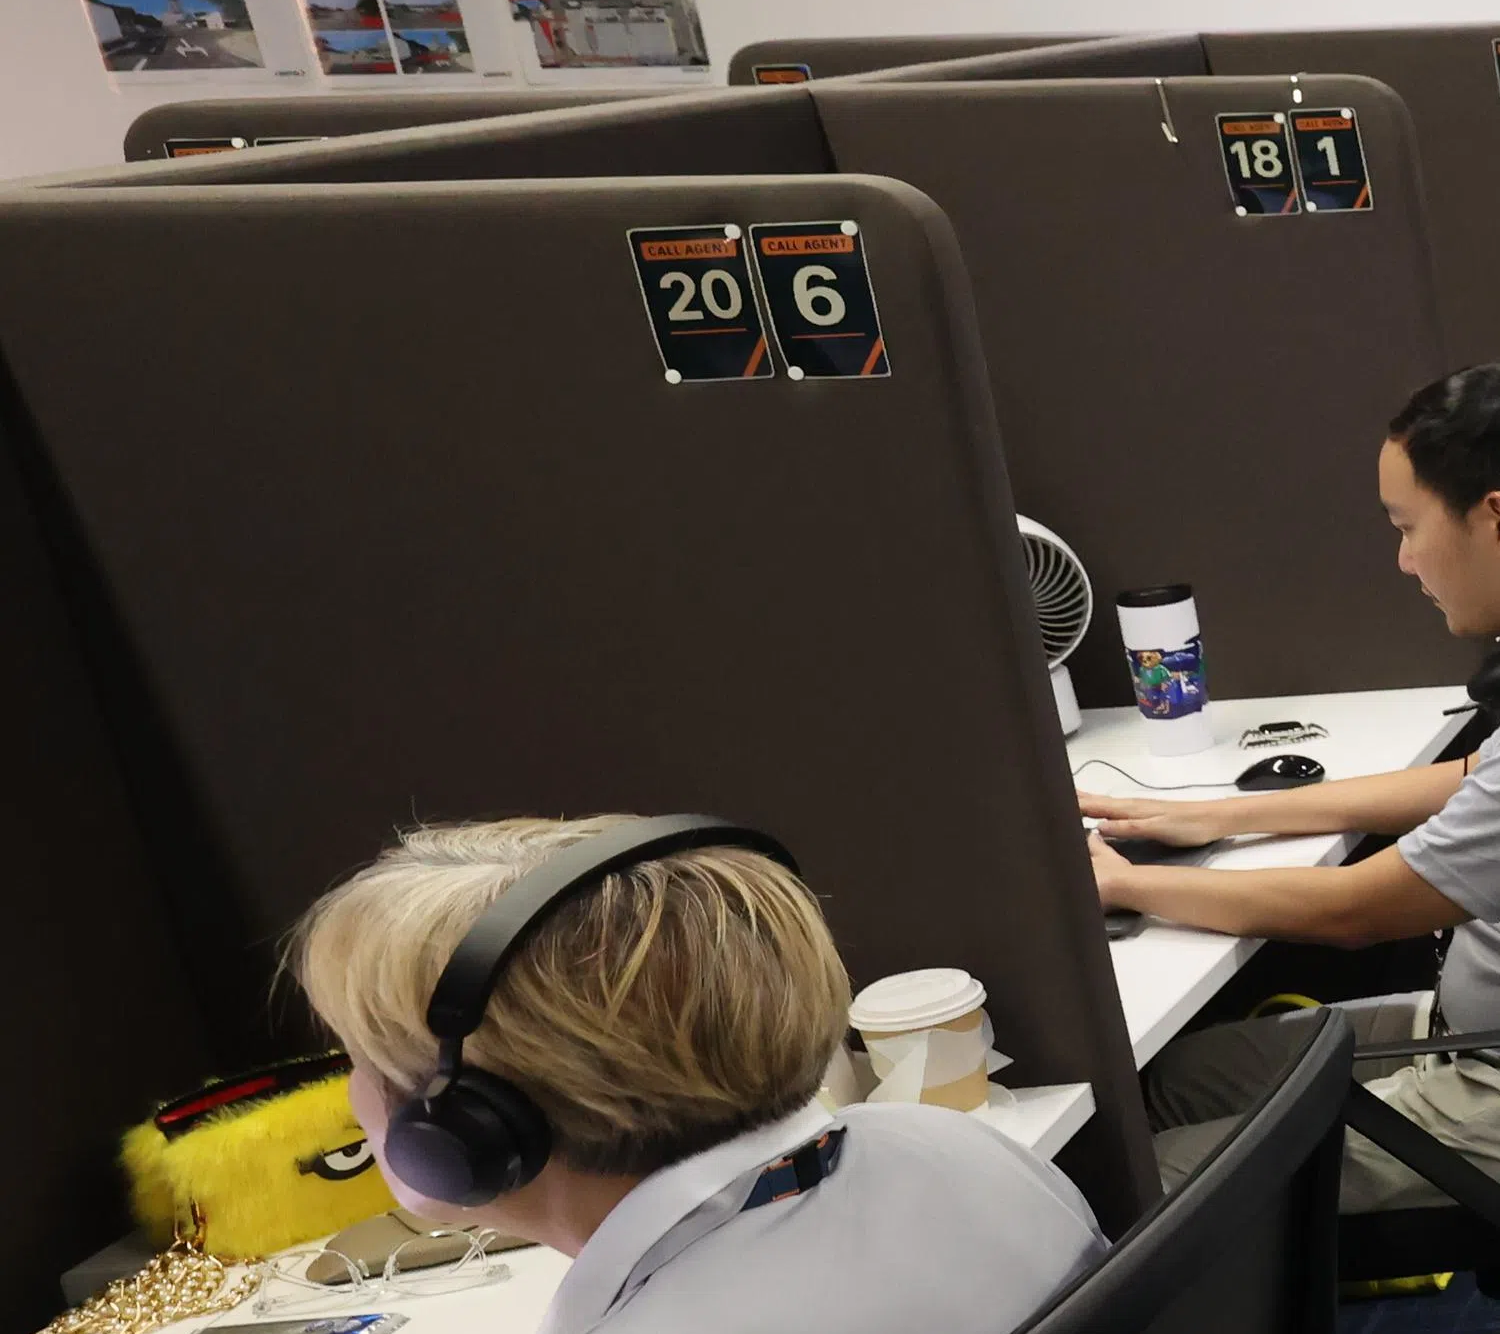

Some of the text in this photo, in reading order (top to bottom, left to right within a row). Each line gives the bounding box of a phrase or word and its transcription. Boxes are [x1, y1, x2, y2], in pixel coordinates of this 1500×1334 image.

[1229, 139, 1283, 179] 18
[1316, 136, 1341, 176] 1
[647, 242, 730, 257] CALL AGENT
[767, 237, 848, 252] CALL AGENT
[659, 269, 743, 321] 20
[792, 265, 846, 326] 6
